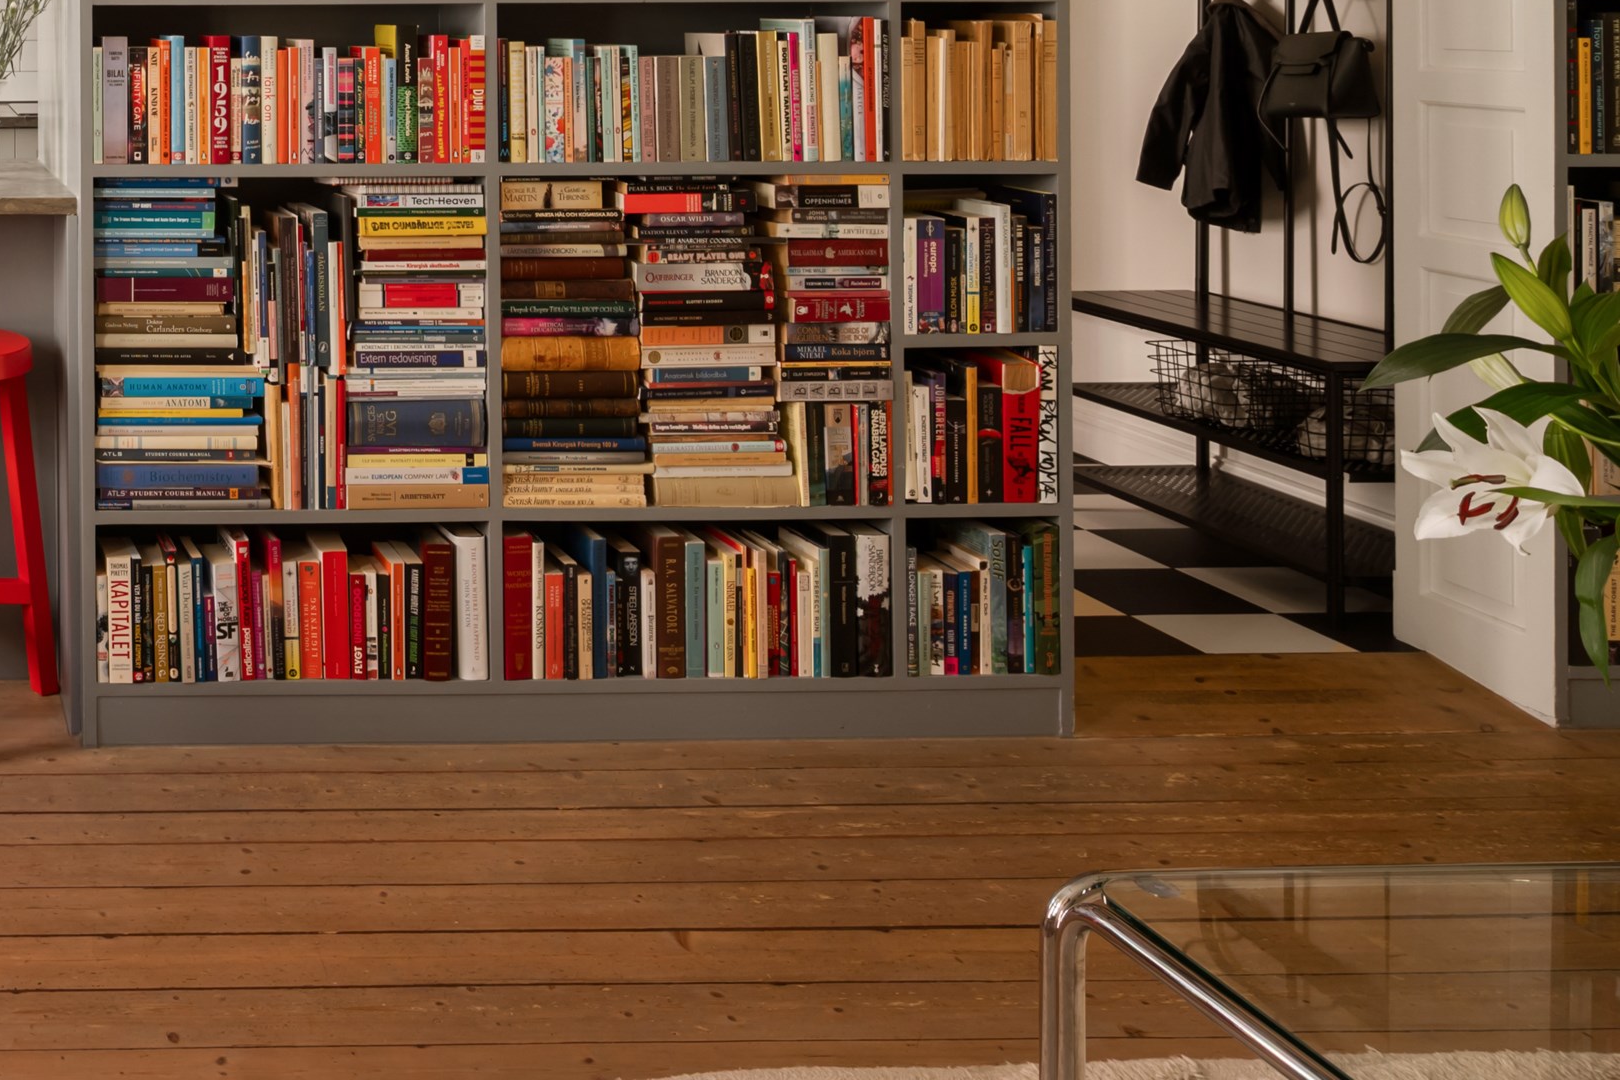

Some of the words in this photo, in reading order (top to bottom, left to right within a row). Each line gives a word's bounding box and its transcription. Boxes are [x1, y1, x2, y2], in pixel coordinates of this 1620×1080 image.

[133, 64, 141, 105] INFINITY
[264, 77, 275, 102] tänk
[792, 69, 800, 101] URBAN
[264, 104, 272, 121] om
[473, 89, 484, 111] DJUR
[133, 106, 141, 130] GATE
[793, 104, 801, 145] EXPRESS
[411, 197, 476, 205] Tech-Heaven
[929, 241, 938, 273] europe
[705, 269, 742, 277] BRANDON
[360, 353, 386, 364] Extern
[389, 353, 438, 366] redovisning
[165, 398, 208, 407] ANATOMY
[935, 384, 944, 409] JOHN
[870, 409, 879, 449] SNABBA
[879, 410, 887, 430] JENS
[936, 411, 945, 440] GREEN
[1010, 417, 1030, 450] FALL
[871, 450, 880, 476] CASH
[879, 431, 887, 476] LAPIDUS
[150, 471, 232, 482] Biochemistry
[665, 558, 676, 577] R.A.
[868, 544, 877, 592] SANDERSON
[875, 549, 884, 588] BRANDON
[993, 539, 1004, 581] SoldF
[182, 570, 190, 587] War
[908, 571, 916, 605] LONGEST
[182, 589, 191, 624] Doctor
[629, 586, 637, 608] STIEG
[666, 583, 678, 633] SALVATORE
[111, 580, 130, 659] KAPITALET
[156, 612, 164, 631] RED
[536, 605, 544, 649] KOSMOS
[629, 608, 638, 646] LARSSON
[909, 607, 917, 627] RACE
[157, 634, 167, 667] RISING
[244, 628, 253, 675] radicalized
